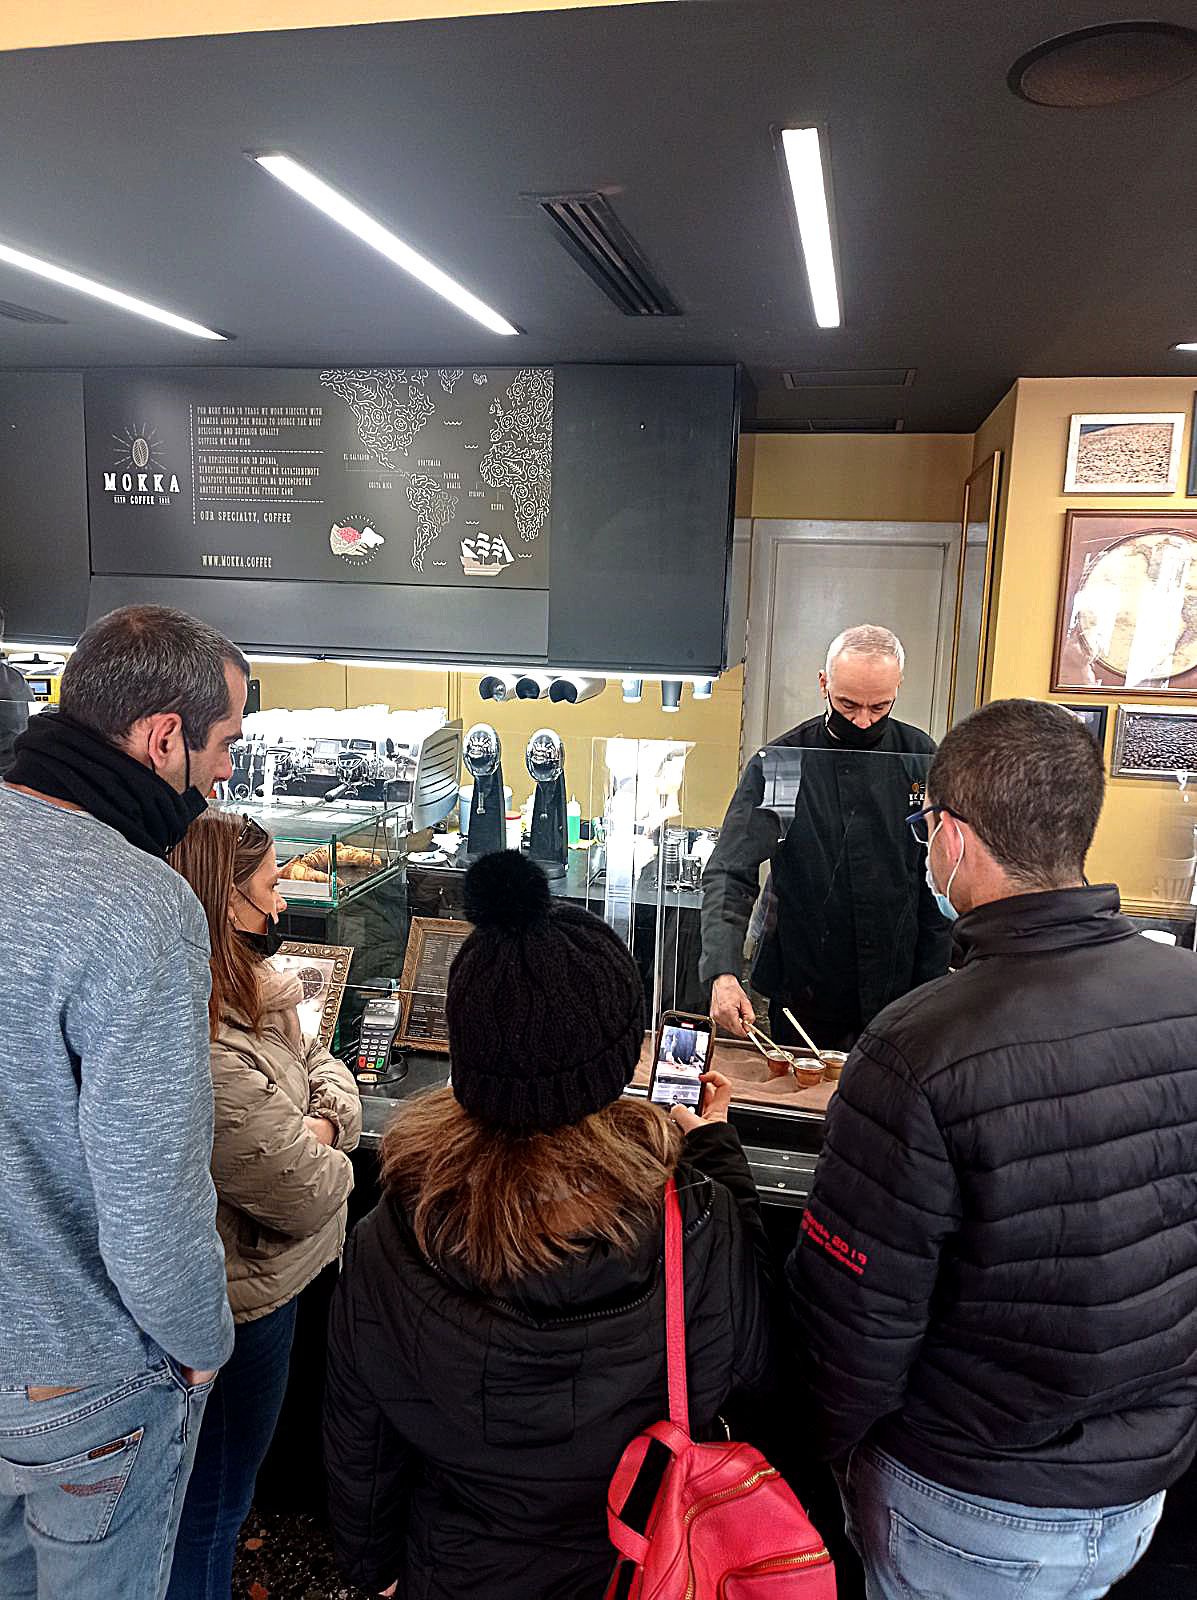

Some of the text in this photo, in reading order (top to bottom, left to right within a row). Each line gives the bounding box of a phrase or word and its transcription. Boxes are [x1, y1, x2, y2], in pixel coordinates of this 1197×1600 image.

[103, 472, 180, 493] MOKKA
[130, 495, 155, 505] COFFEE
[200, 510, 292, 524] OUR SPECIALTY, COFFEE
[201, 555, 272, 568] WWW.MOKKA.COFFEE
